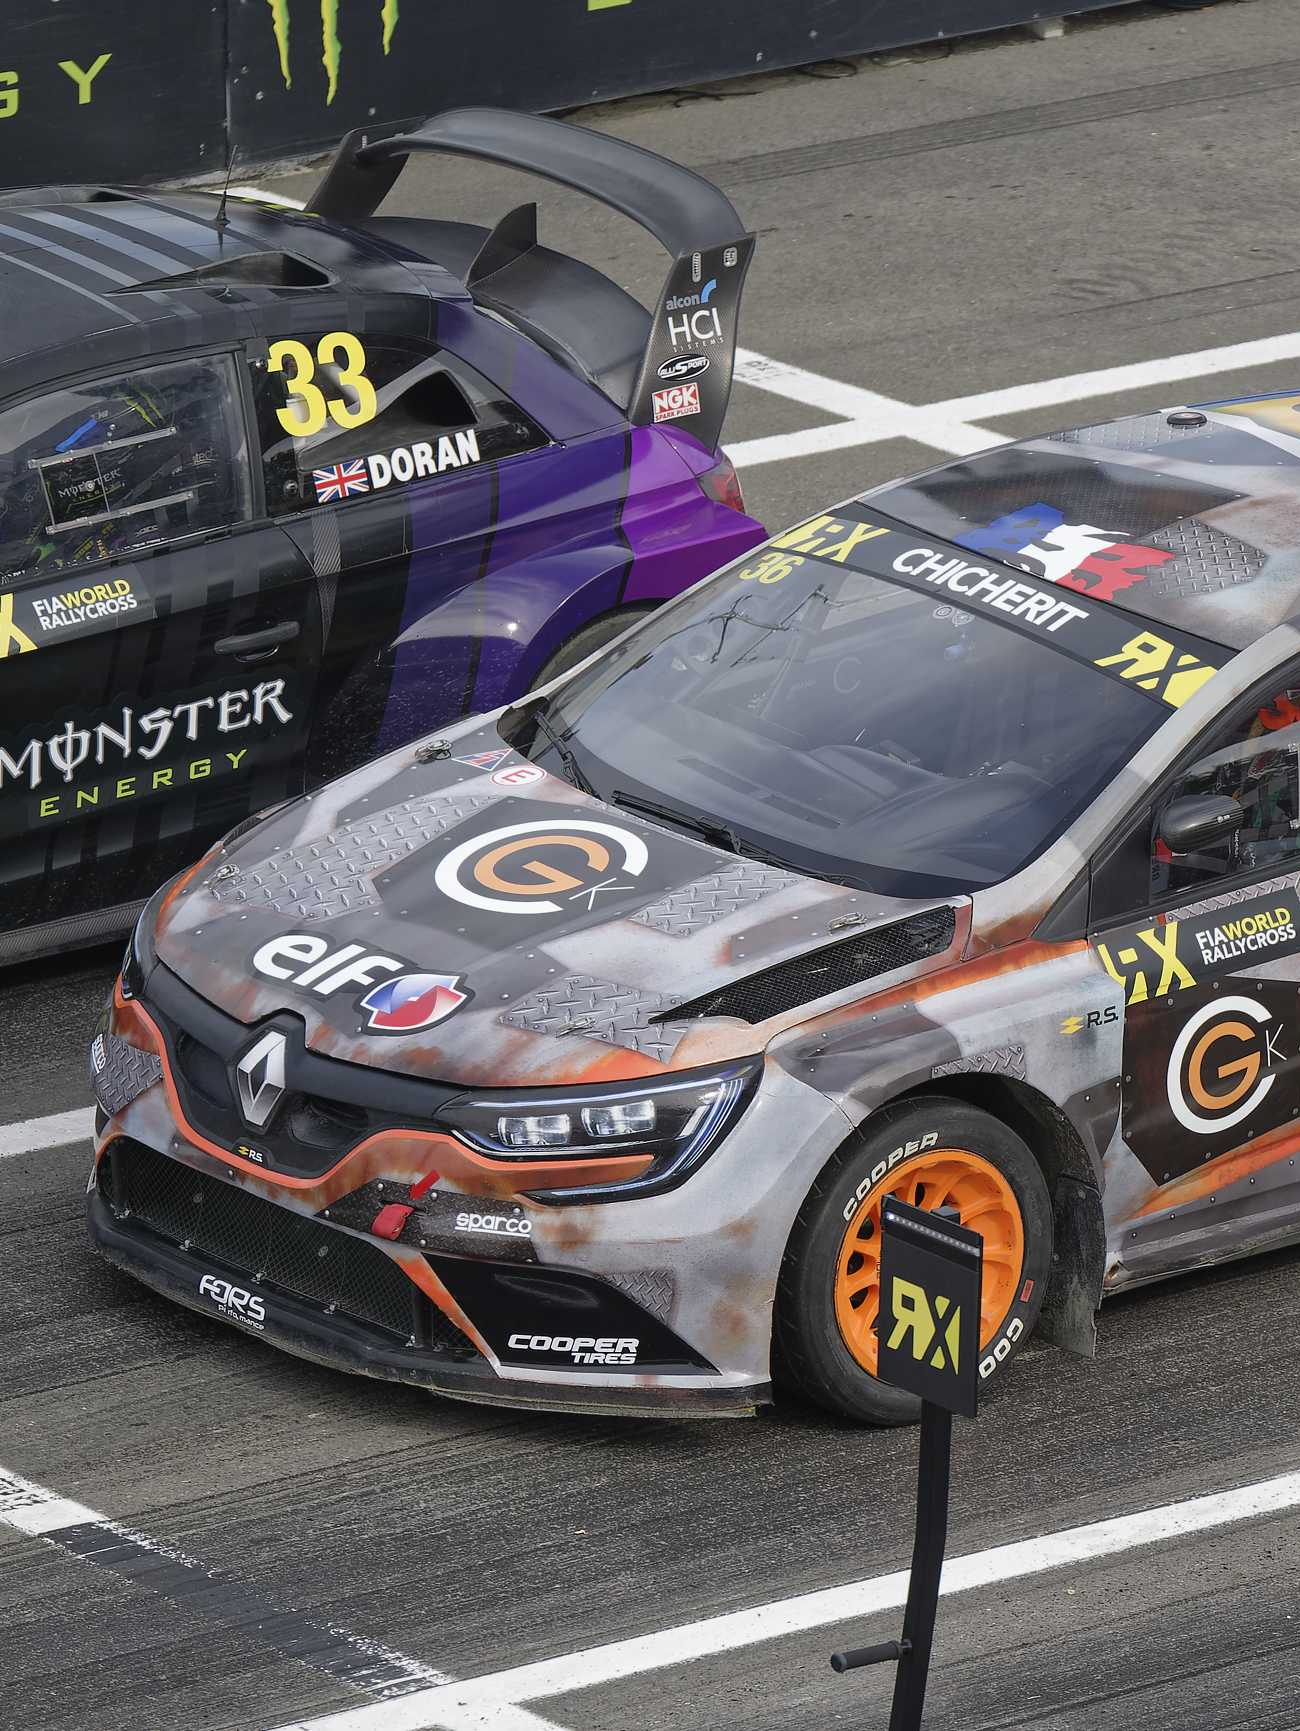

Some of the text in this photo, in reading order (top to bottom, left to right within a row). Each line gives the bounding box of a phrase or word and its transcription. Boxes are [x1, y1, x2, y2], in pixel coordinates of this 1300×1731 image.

[666, 294, 700, 311] alcon
[668, 307, 722, 346] HCI
[267, 332, 377, 437] 33
[655, 385, 698, 414] NGK
[367, 429, 480, 489] DORAN
[738, 551, 805, 584] 36
[892, 548, 1090, 632] CHICHERIT
[39, 594, 138, 631] RALLYCROSS
[0, 678, 293, 789] MONSTER
[40, 749, 247, 817] ENERGY
[1202, 923, 1297, 965] RALLYCROSS
[253, 935, 405, 996] elf
[1087, 1006, 1119, 1028] R.S.
[842, 1131, 938, 1222] COOPER
[455, 1213, 532, 1237] sparco
[508, 1334, 639, 1353] COOPER
[571, 1353, 637, 1364] TIRES
